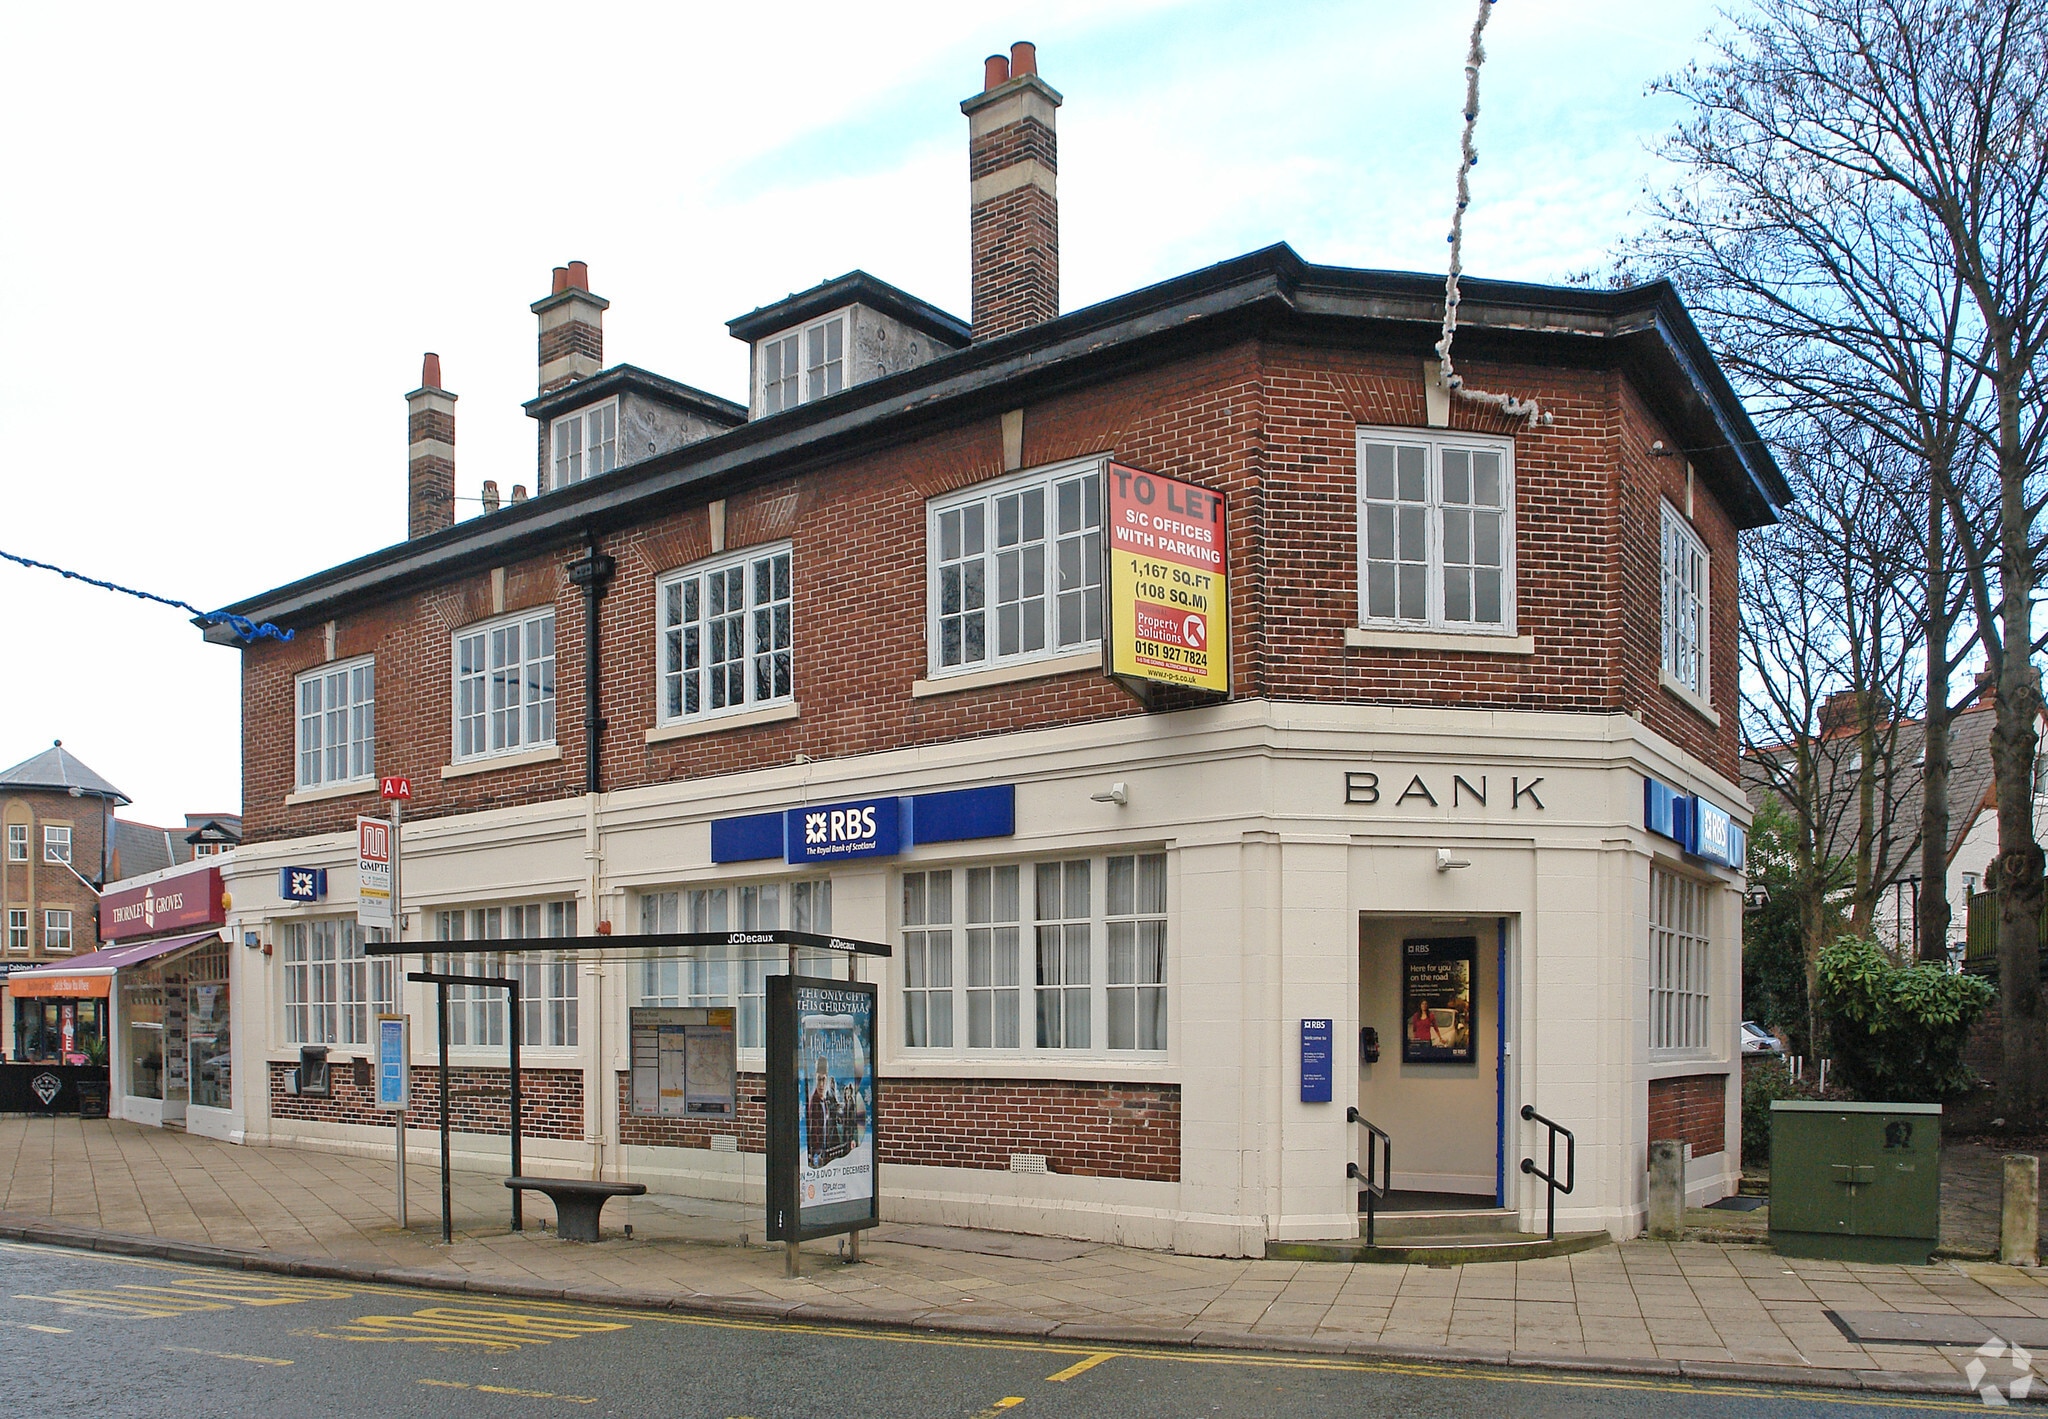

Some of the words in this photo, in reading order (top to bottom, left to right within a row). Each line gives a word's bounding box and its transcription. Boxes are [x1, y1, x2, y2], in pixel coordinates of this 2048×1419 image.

[1113, 468, 1155, 505] TO
[1167, 483, 1222, 523] LET
[1126, 509, 1149, 527] S/C
[1153, 516, 1212, 543] OFFICES
[1116, 525, 1155, 548] WITH
[1158, 536, 1221, 564] PARKING
[1131, 560, 1168, 579] 1,167
[1173, 569, 1211, 590] SQ.FT
[1135, 581, 1165, 600] (108
[1169, 589, 1208, 613] SQ.M)
[1138, 612, 1179, 634] Property
[1138, 625, 1182, 644] Solutions
[1135, 640, 1159, 658] 0161
[1163, 646, 1181, 661] 927
[1184, 650, 1208, 667] 7824
[1148, 669, 1197, 684] www.r-p-s.co.uk
[384, 780, 394, 794] A
[399, 781, 409, 796] A
[1344, 771, 1545, 810] BANK
[831, 806, 876, 842] RBS
[1712, 811, 1726, 848] RBS
[807, 847, 816, 855] The
[817, 845, 831, 855] Royal
[832, 844, 845, 853] Bank
[846, 842, 852, 853] of
[853, 841, 876, 851] Scotland
[360, 860, 390, 874] GMPTE
[113, 901, 145, 923] THORNLEY
[156, 893, 183, 913] GROVES
[727, 933, 774, 944] JCDecaux
[829, 939, 856, 950] JCDecaux
[1415, 944, 1430, 953] RBS
[1410, 964, 1426, 972] Here
[1427, 963, 1436, 971] for
[1438, 965, 1451, 973] you
[1433, 972, 1449, 981] road
[800, 988, 818, 999] THE
[820, 990, 844, 1001] ONLY
[845, 991, 867, 1002] GIFT
[797, 1000, 818, 1011] THIS
[819, 1001, 869, 1014] CHRISTMAS
[1311, 1021, 1325, 1029] RBS
[821, 1169, 832, 1178] DVD
[843, 1165, 870, 1176] DECEMBER
